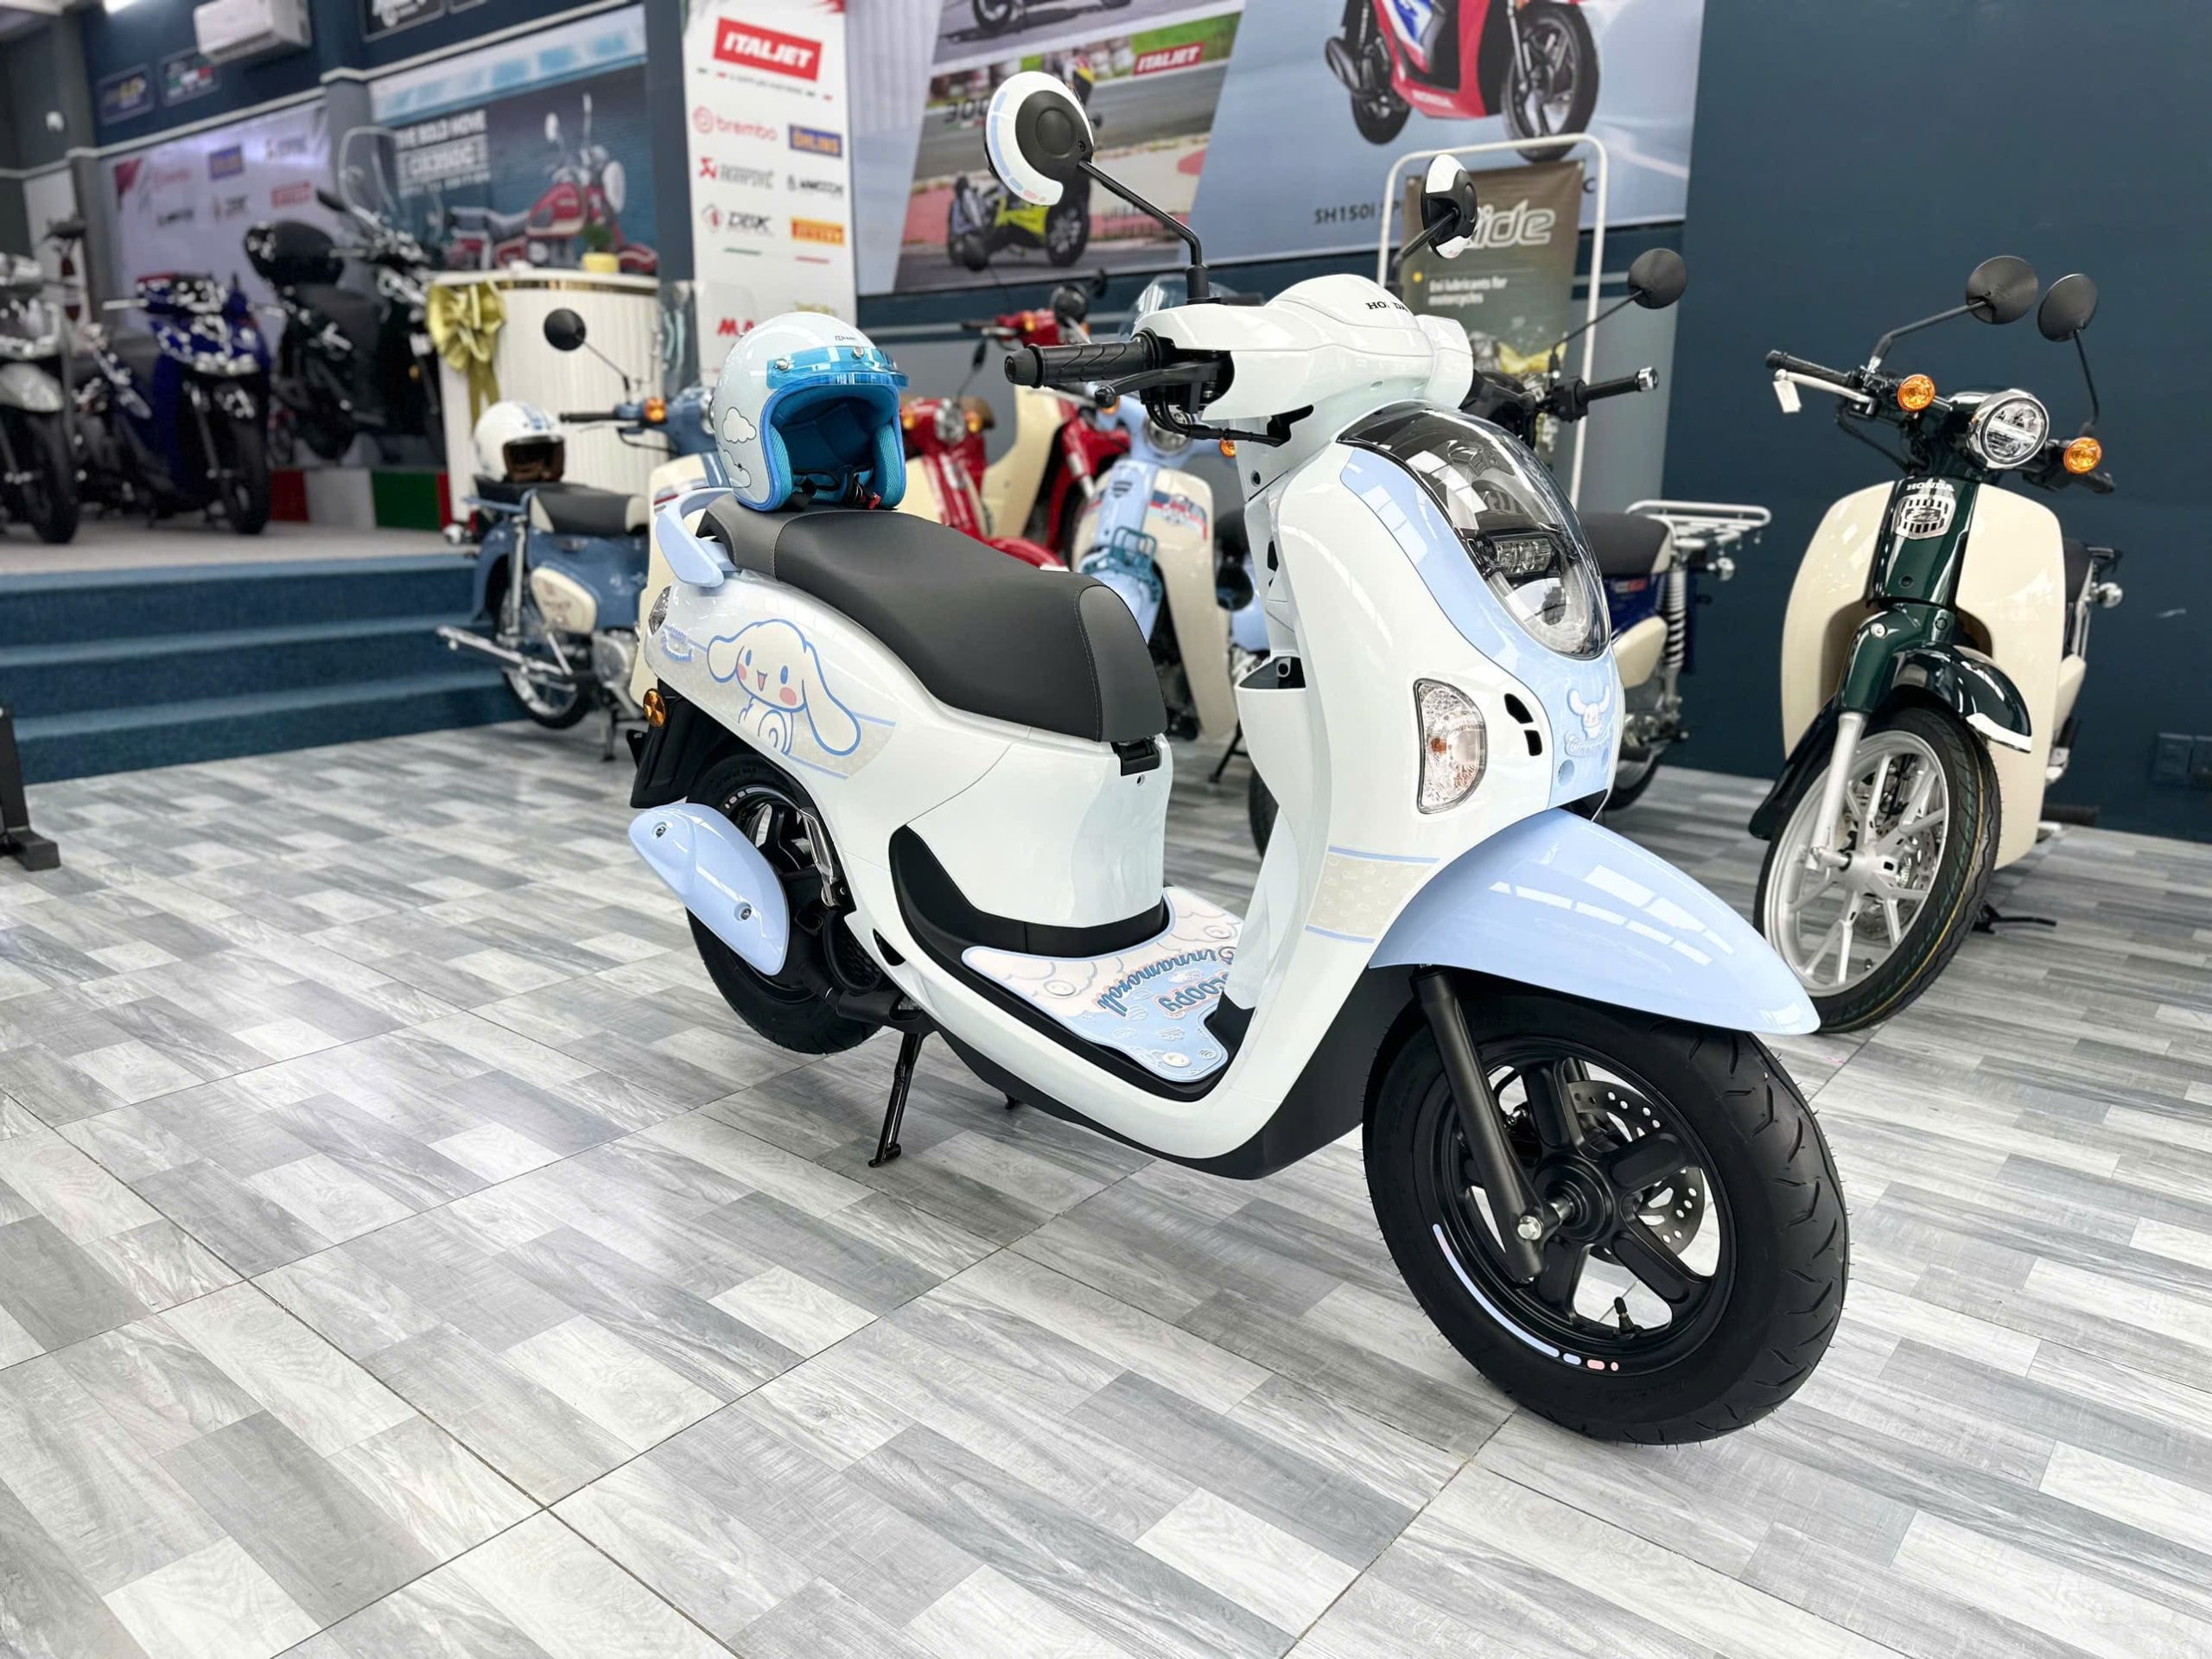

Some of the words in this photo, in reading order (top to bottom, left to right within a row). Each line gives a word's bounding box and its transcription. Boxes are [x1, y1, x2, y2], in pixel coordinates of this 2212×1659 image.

[722, 31, 814, 69] ITALJET
[1136, 45, 1201, 73] ITALJET
[716, 115, 778, 142] brembo
[1365, 301, 1409, 313] HODA
[1906, 481, 1955, 492] HONDA
[1158, 973, 1229, 1012] coopy
